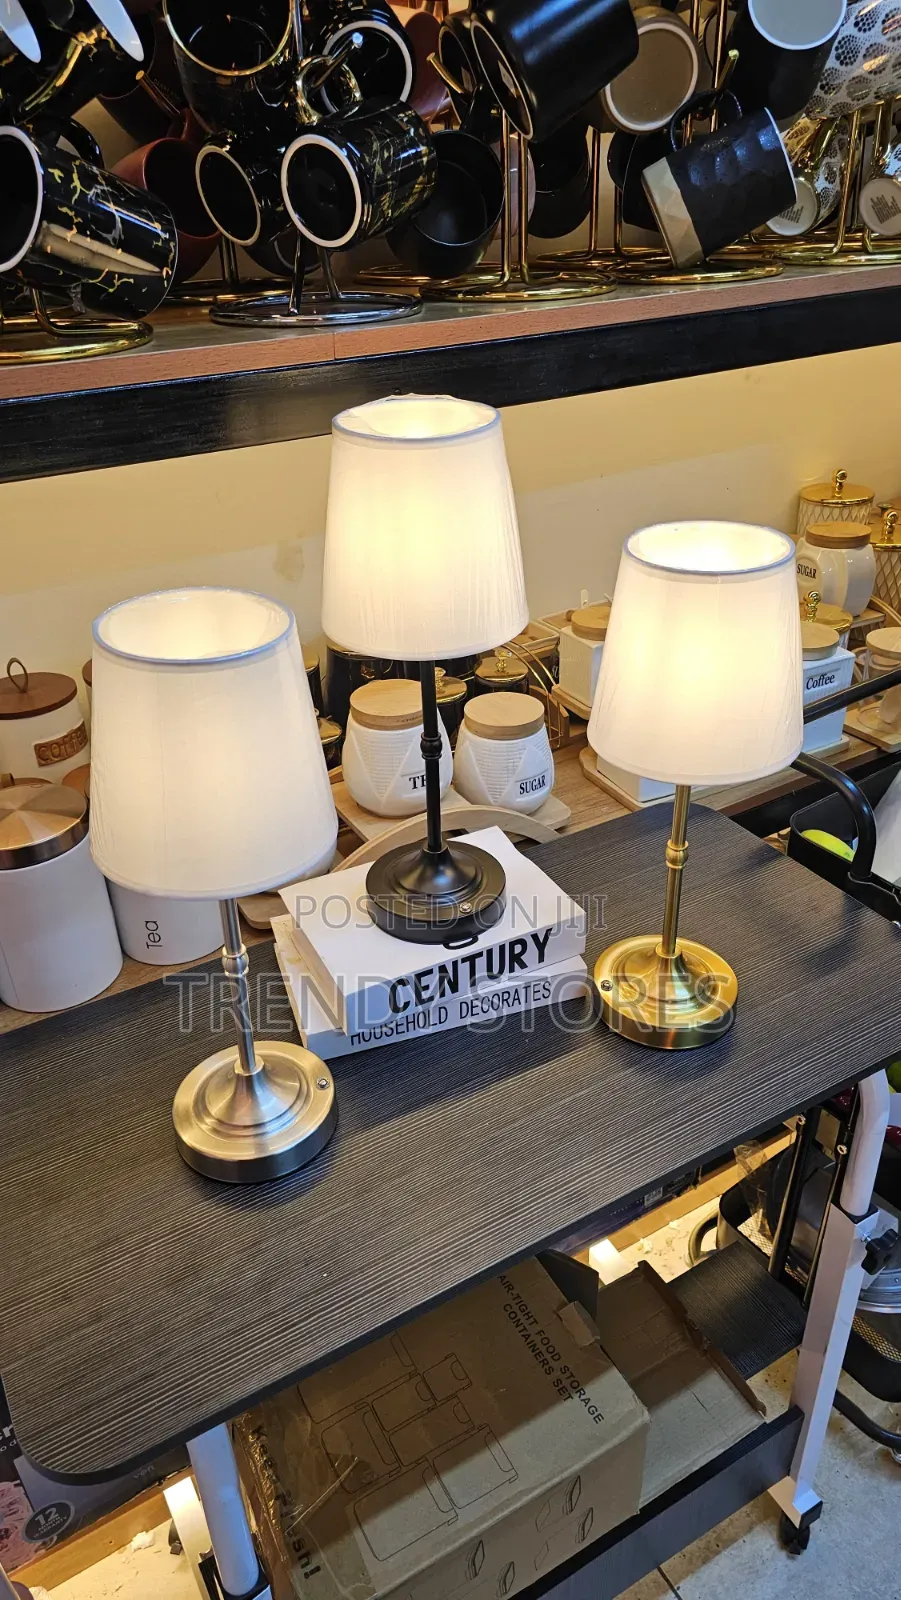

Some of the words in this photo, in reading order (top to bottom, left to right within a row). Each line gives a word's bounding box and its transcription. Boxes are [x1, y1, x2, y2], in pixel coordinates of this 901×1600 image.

[796, 563, 817, 579] SUGAR
[806, 673, 836, 690] Coffee
[408, 774, 427, 790] TE
[519, 774, 546, 795] SUGAR
[144, 920, 163, 949] Tea
[388, 927, 554, 1014] CENTURY
[350, 1006, 448, 1046] HOUSEHOLD
[459, 981, 552, 1019] DECORATES
[498, 1275, 539, 1327] AIR-TIGHT
[535, 1329, 562, 1362] FOOD
[560, 1365, 605, 1424] STORAGE
[503, 1303, 554, 1376] CONTAINERS
[553, 1378, 574, 1402] SET
[35, 1507, 60, 1525] 12
